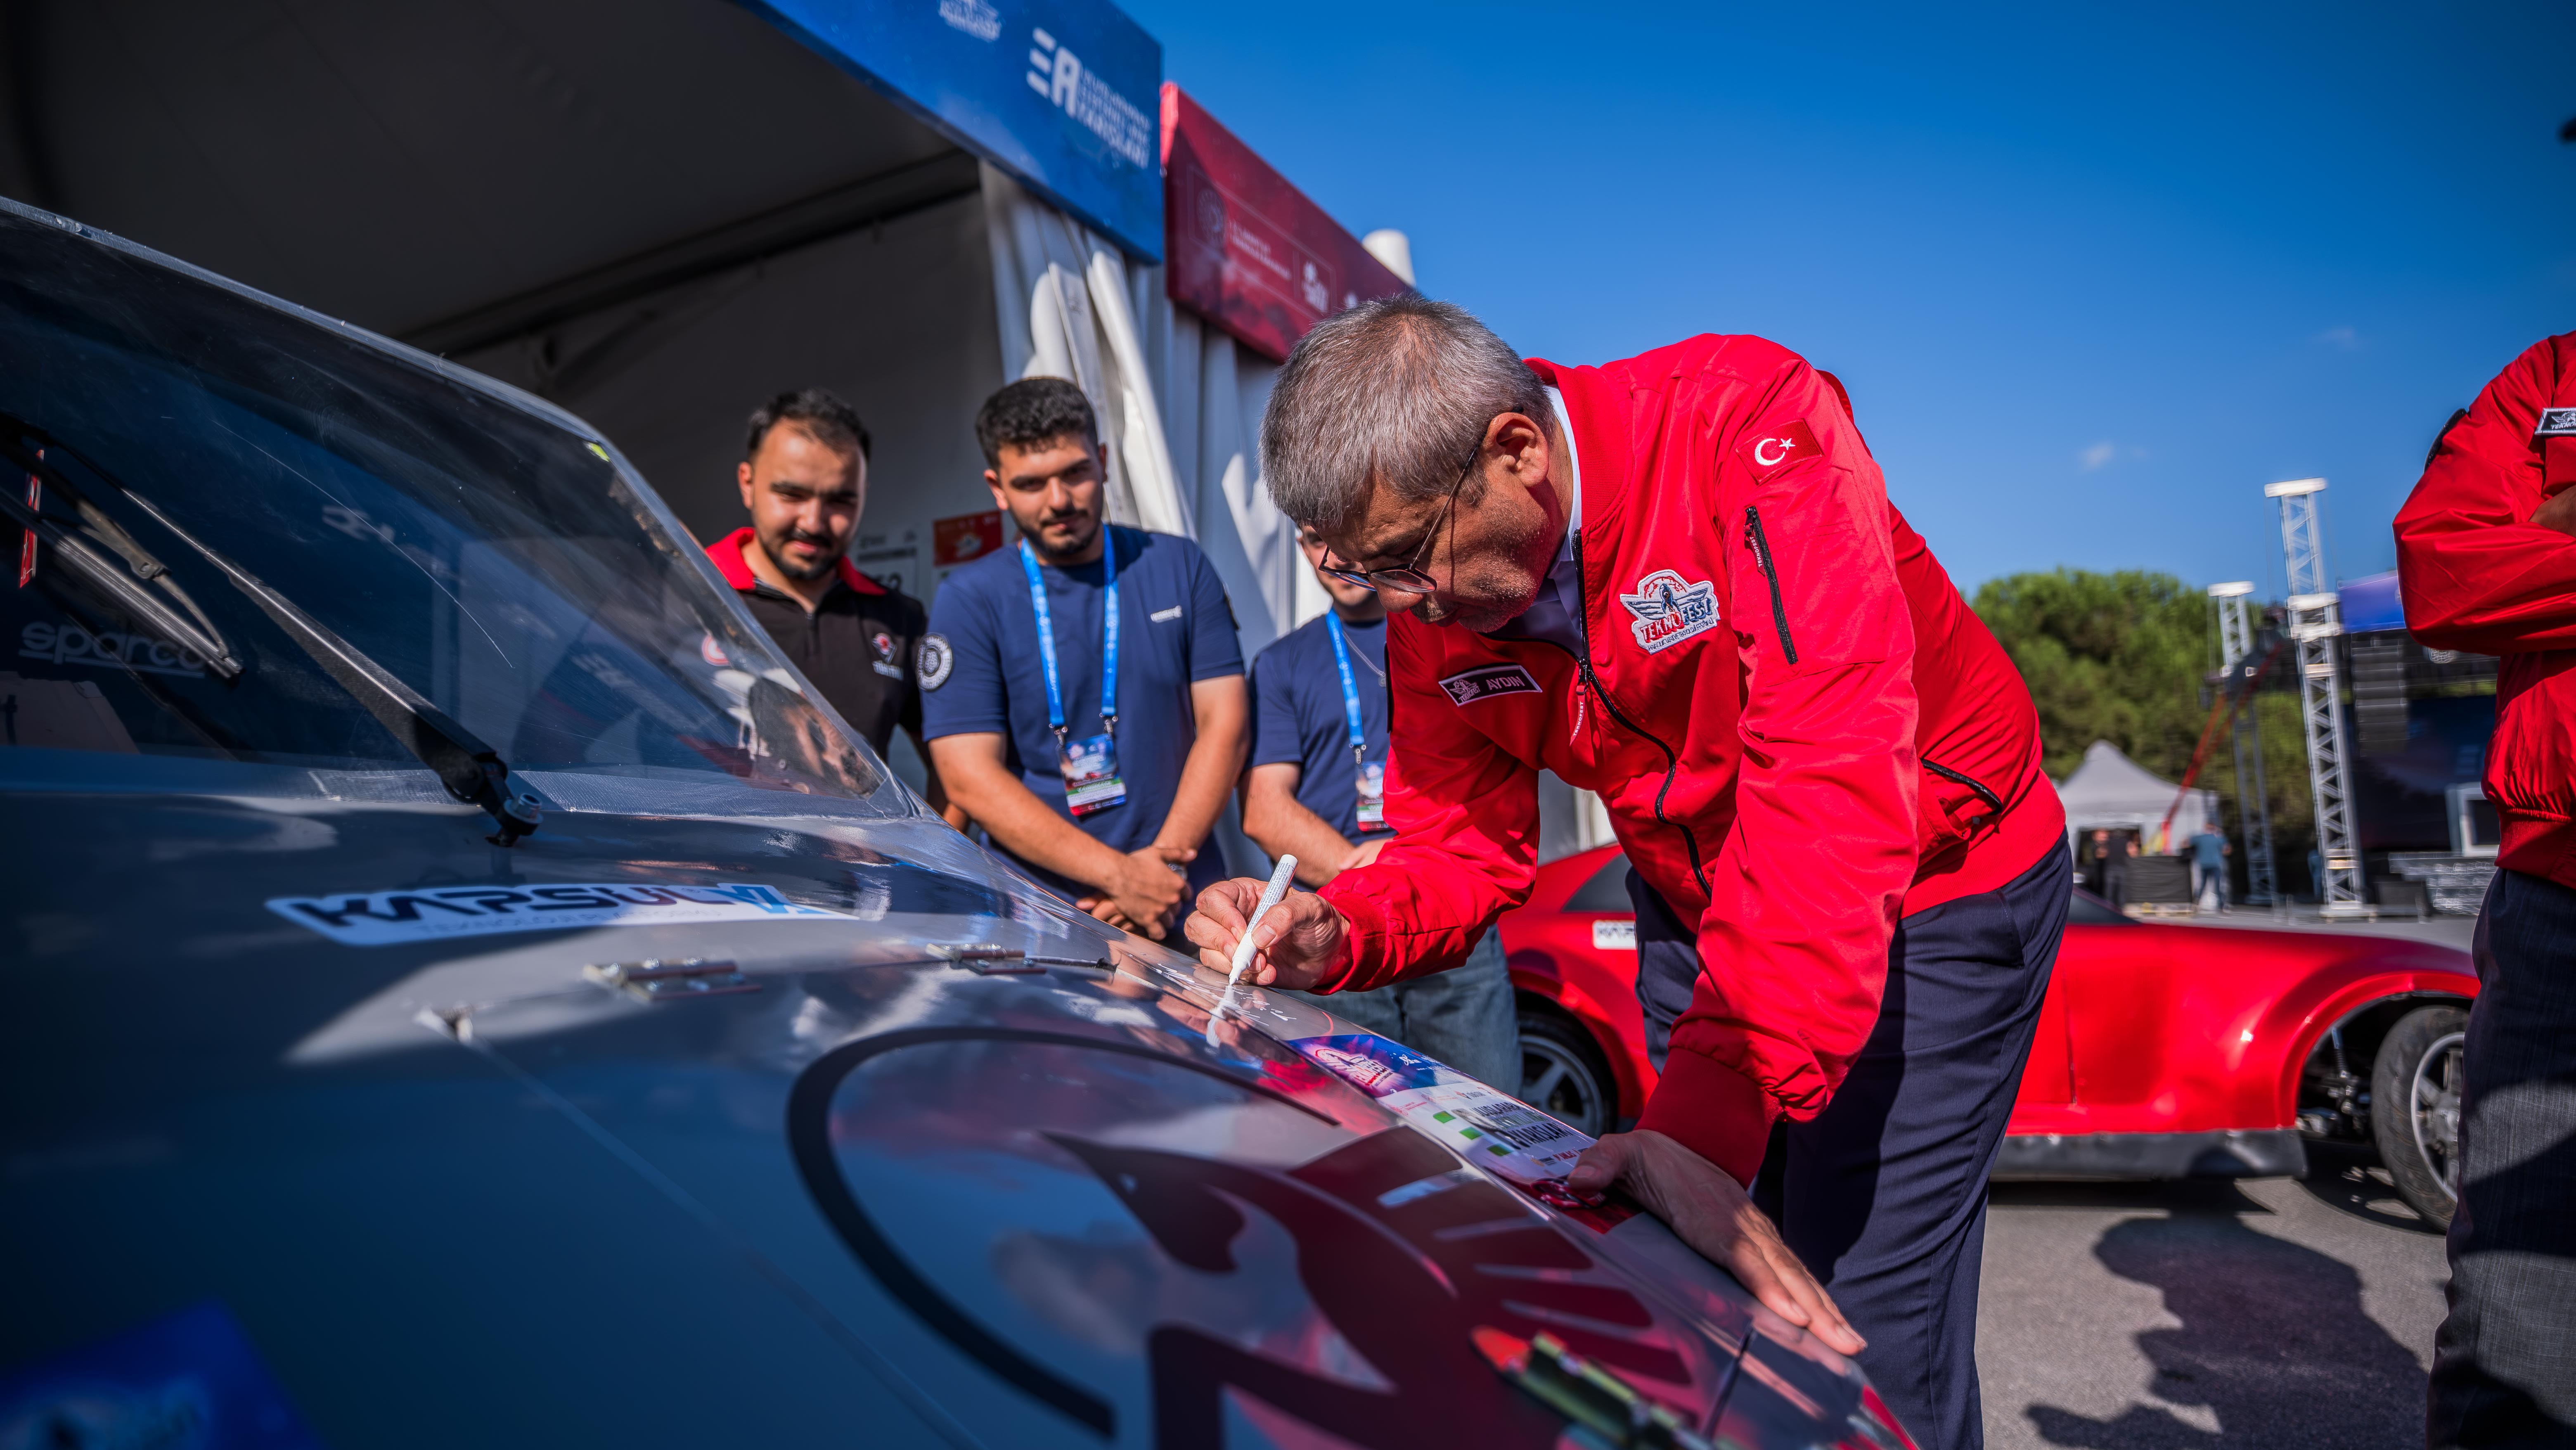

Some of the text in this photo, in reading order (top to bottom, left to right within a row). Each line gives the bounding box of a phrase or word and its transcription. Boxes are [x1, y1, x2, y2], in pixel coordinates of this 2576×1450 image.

[1750, 537, 1763, 568] TEKNOFEST
[1640, 597, 1712, 643] TEKNOFEST
[18, 621, 207, 671] sparco
[1458, 685, 1480, 702] TEKNOFEST
[1486, 676, 1525, 690] AYDIN
[1573, 701, 1584, 736] TEKNOFEST
